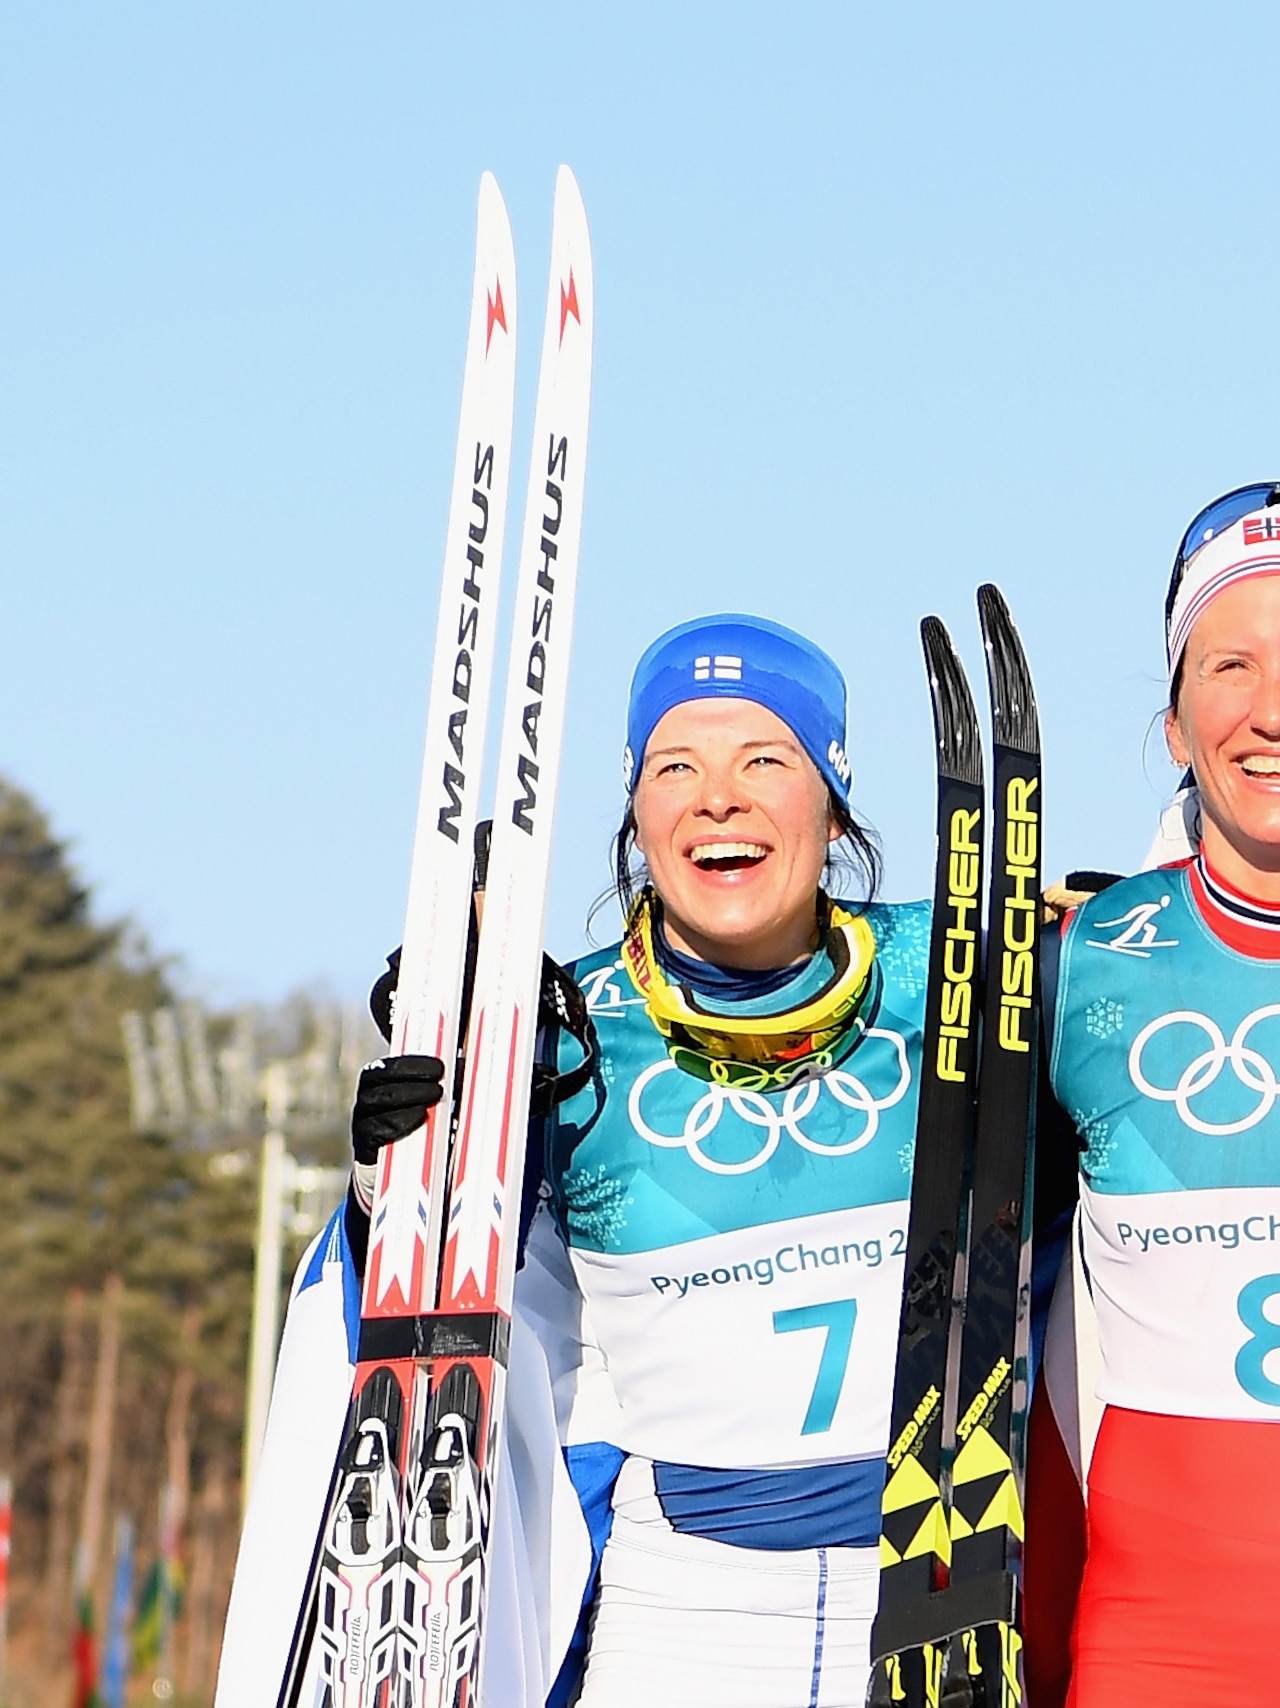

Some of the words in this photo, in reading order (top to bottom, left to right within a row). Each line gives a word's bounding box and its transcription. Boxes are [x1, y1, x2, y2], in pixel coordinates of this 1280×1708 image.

[437, 440, 494, 845] MADSHUS
[512, 432, 568, 836] MADSHUS
[936, 808, 981, 1083] FISCHER
[998, 776, 1038, 1053] FISCHER
[650, 1239, 883, 1299] PyeongChang
[889, 1229, 907, 1256] 2
[772, 1298, 857, 1436] 7
[887, 1420, 918, 1470] SPEED
[913, 1384, 942, 1430] MAX
[955, 1390, 989, 1441] SPEED
[983, 1356, 1012, 1402] MAX
